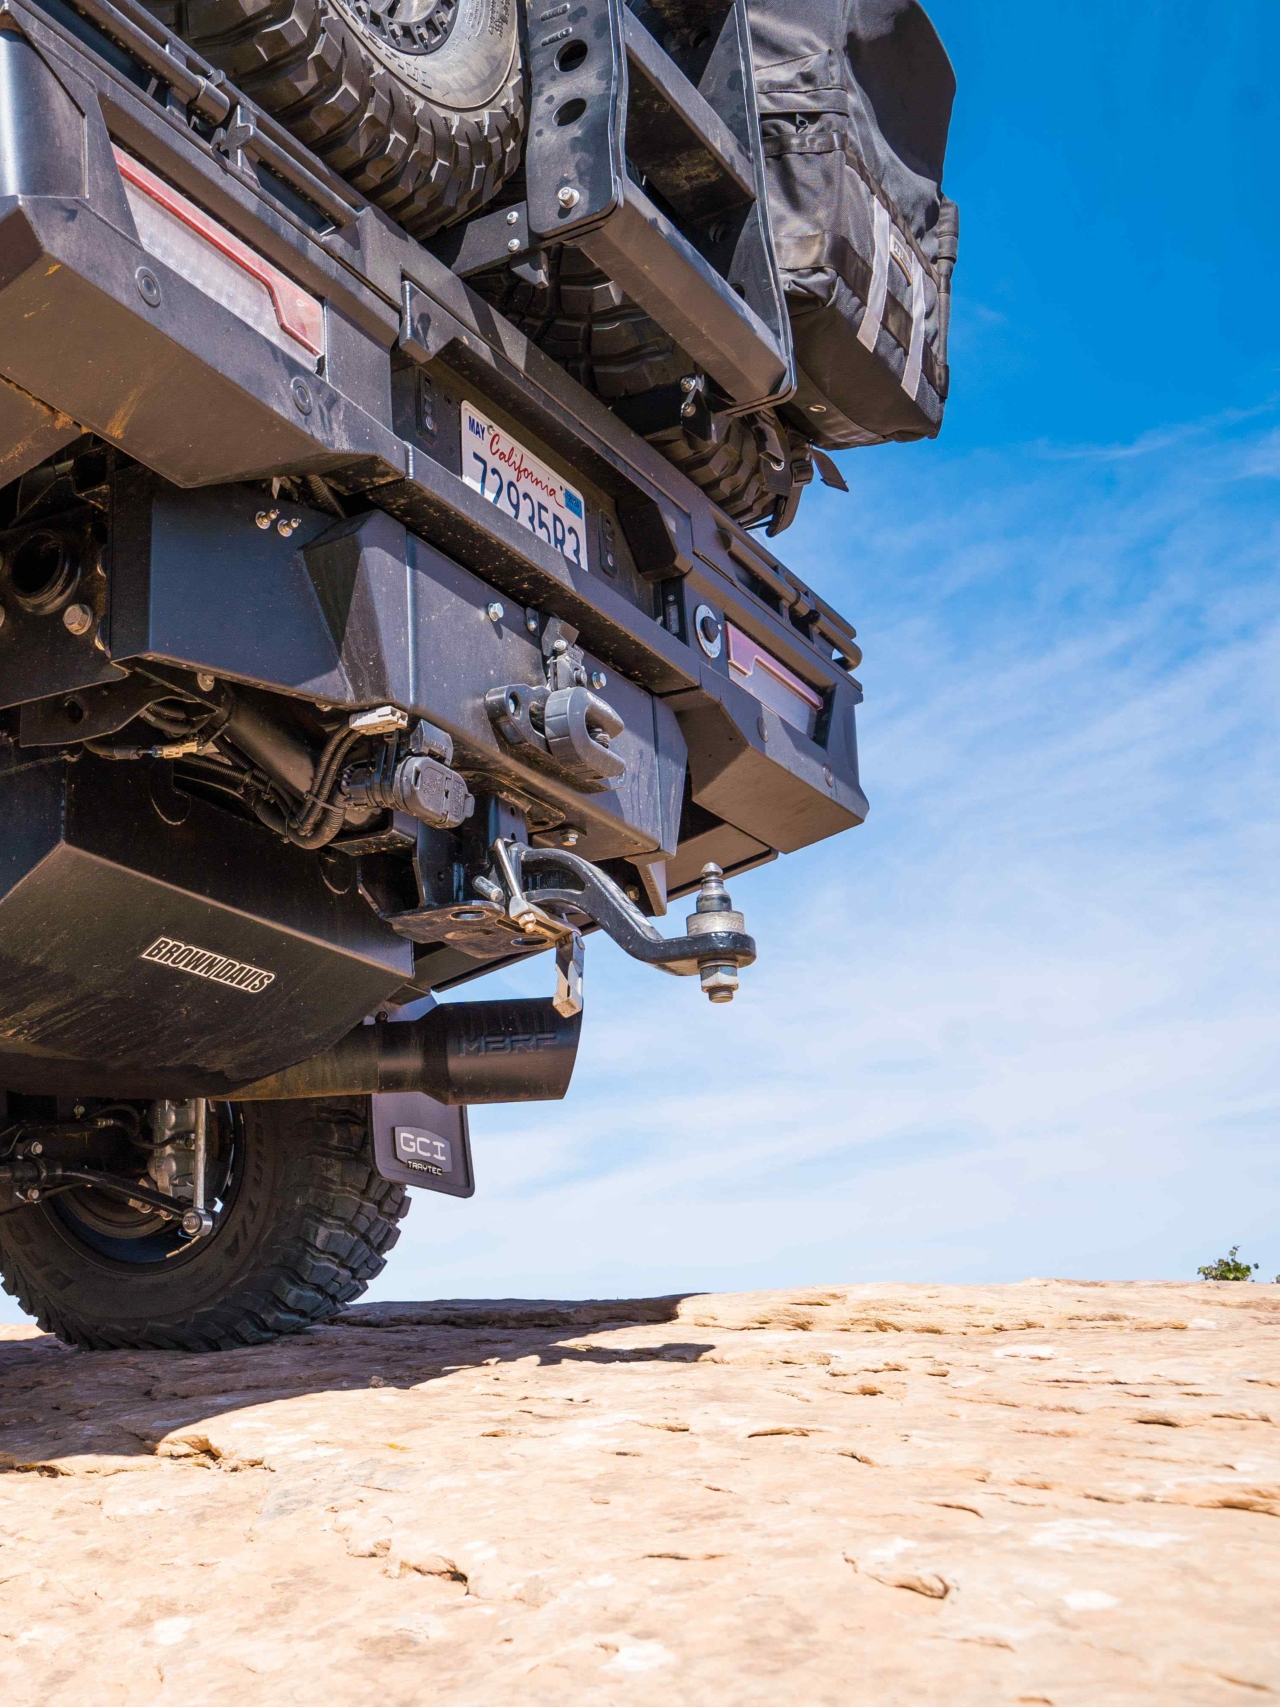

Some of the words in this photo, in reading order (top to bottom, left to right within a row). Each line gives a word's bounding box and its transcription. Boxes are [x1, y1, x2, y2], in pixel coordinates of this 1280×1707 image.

[468, 415, 486, 441] MAY
[489, 433, 564, 509] California
[459, 1032, 558, 1056] MBRP
[400, 1132, 446, 1160] GCI
[407, 1160, 442, 1176] TRAYTEC
